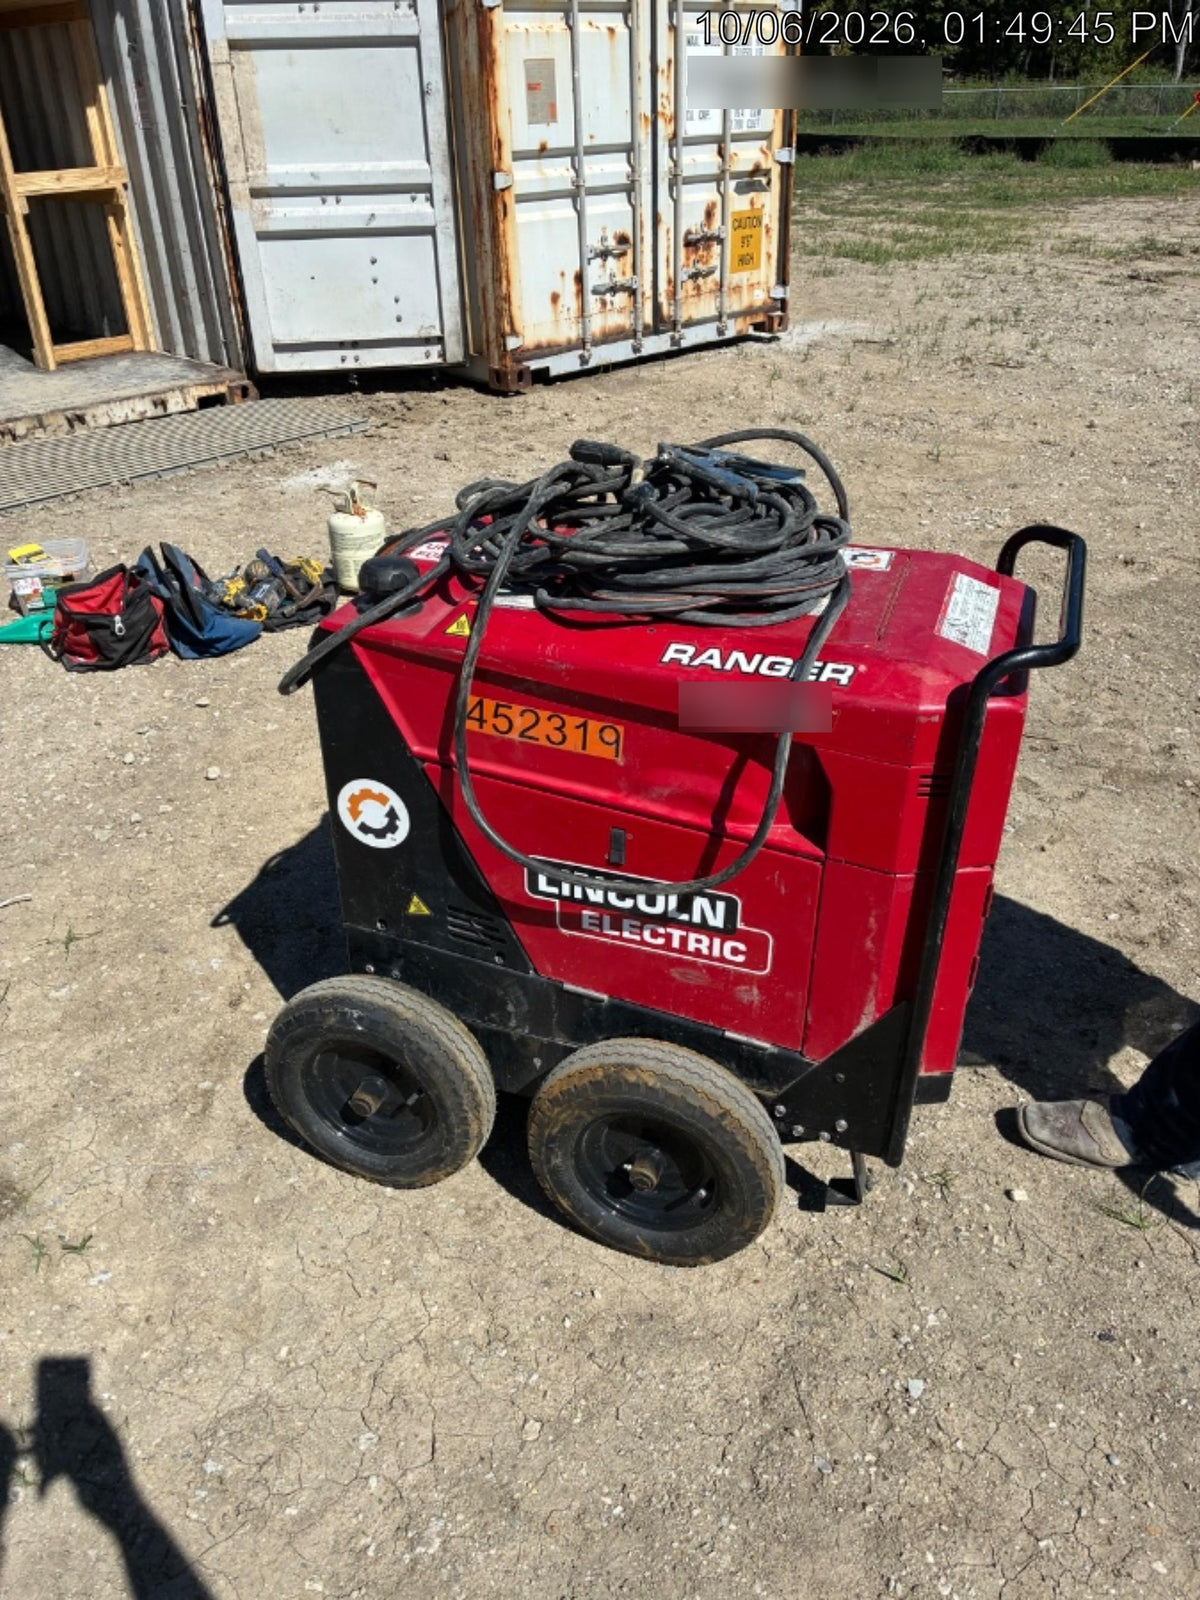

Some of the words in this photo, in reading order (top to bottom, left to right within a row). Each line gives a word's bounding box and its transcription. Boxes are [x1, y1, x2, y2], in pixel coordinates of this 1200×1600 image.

[732, 216, 762, 231] CAUTION
[737, 253, 754, 267] HIGH
[466, 698, 620, 758] 452319
[581, 910, 747, 963] ELECTRIC
